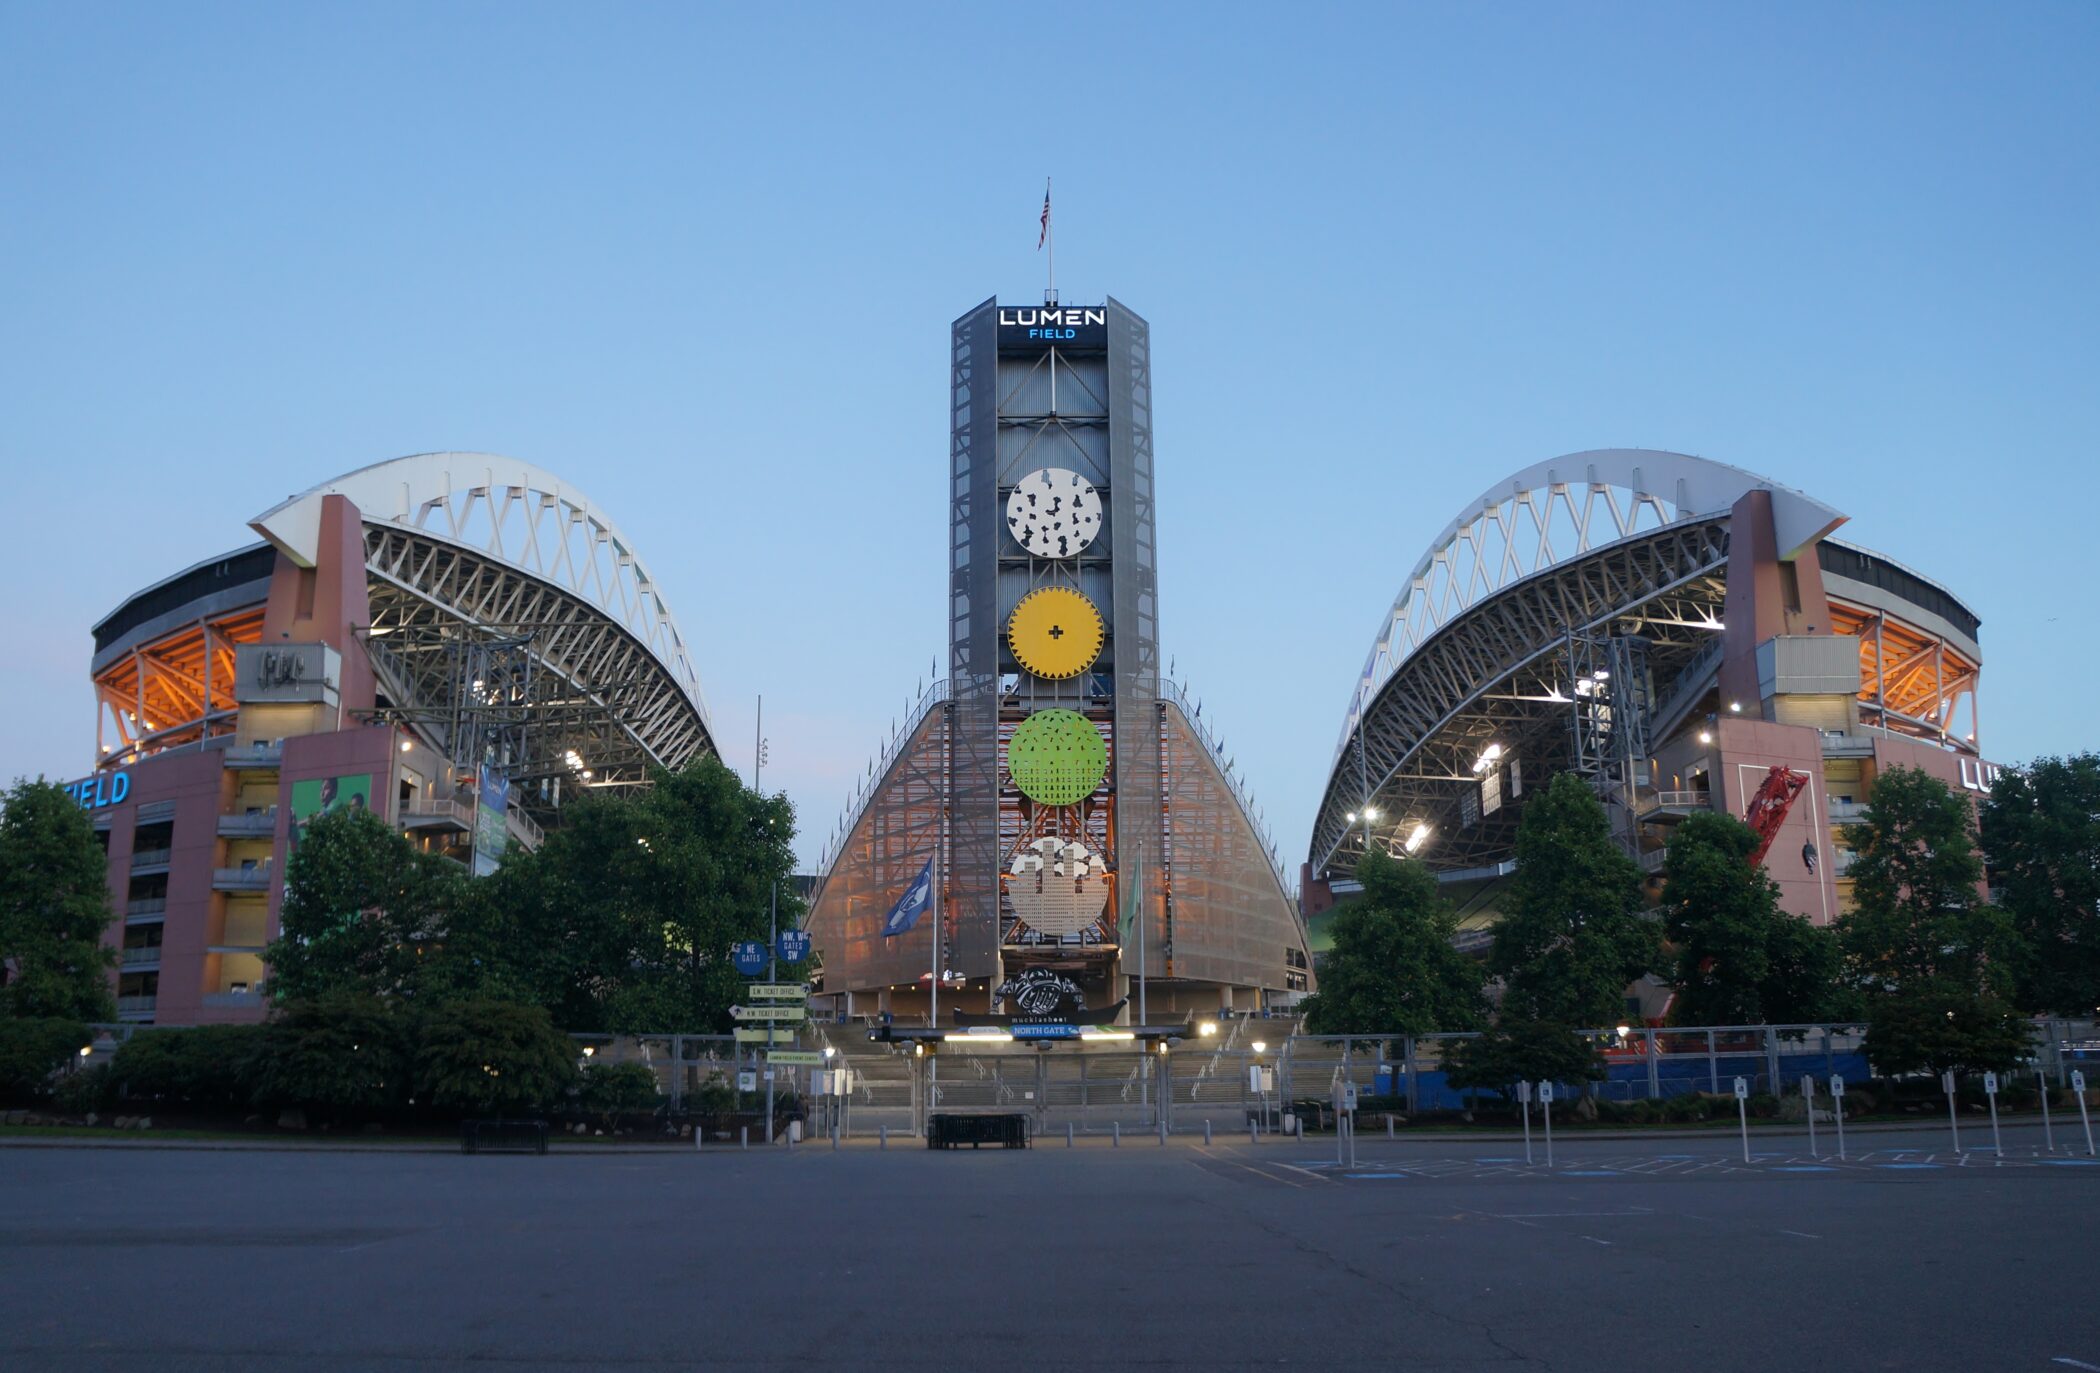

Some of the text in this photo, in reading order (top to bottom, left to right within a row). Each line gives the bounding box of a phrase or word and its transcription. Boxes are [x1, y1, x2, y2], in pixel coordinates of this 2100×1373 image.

[1000, 310, 1104, 325] LUMEN
[1029, 329, 1075, 339] FIELD
[63, 772, 129, 810] IELD
[746, 944, 755, 954] NE
[784, 942, 803, 950] GATES
[741, 954, 760, 962] GATES
[787, 950, 798, 960] SW
[1014, 1026, 1065, 1035] NORTH GATE
